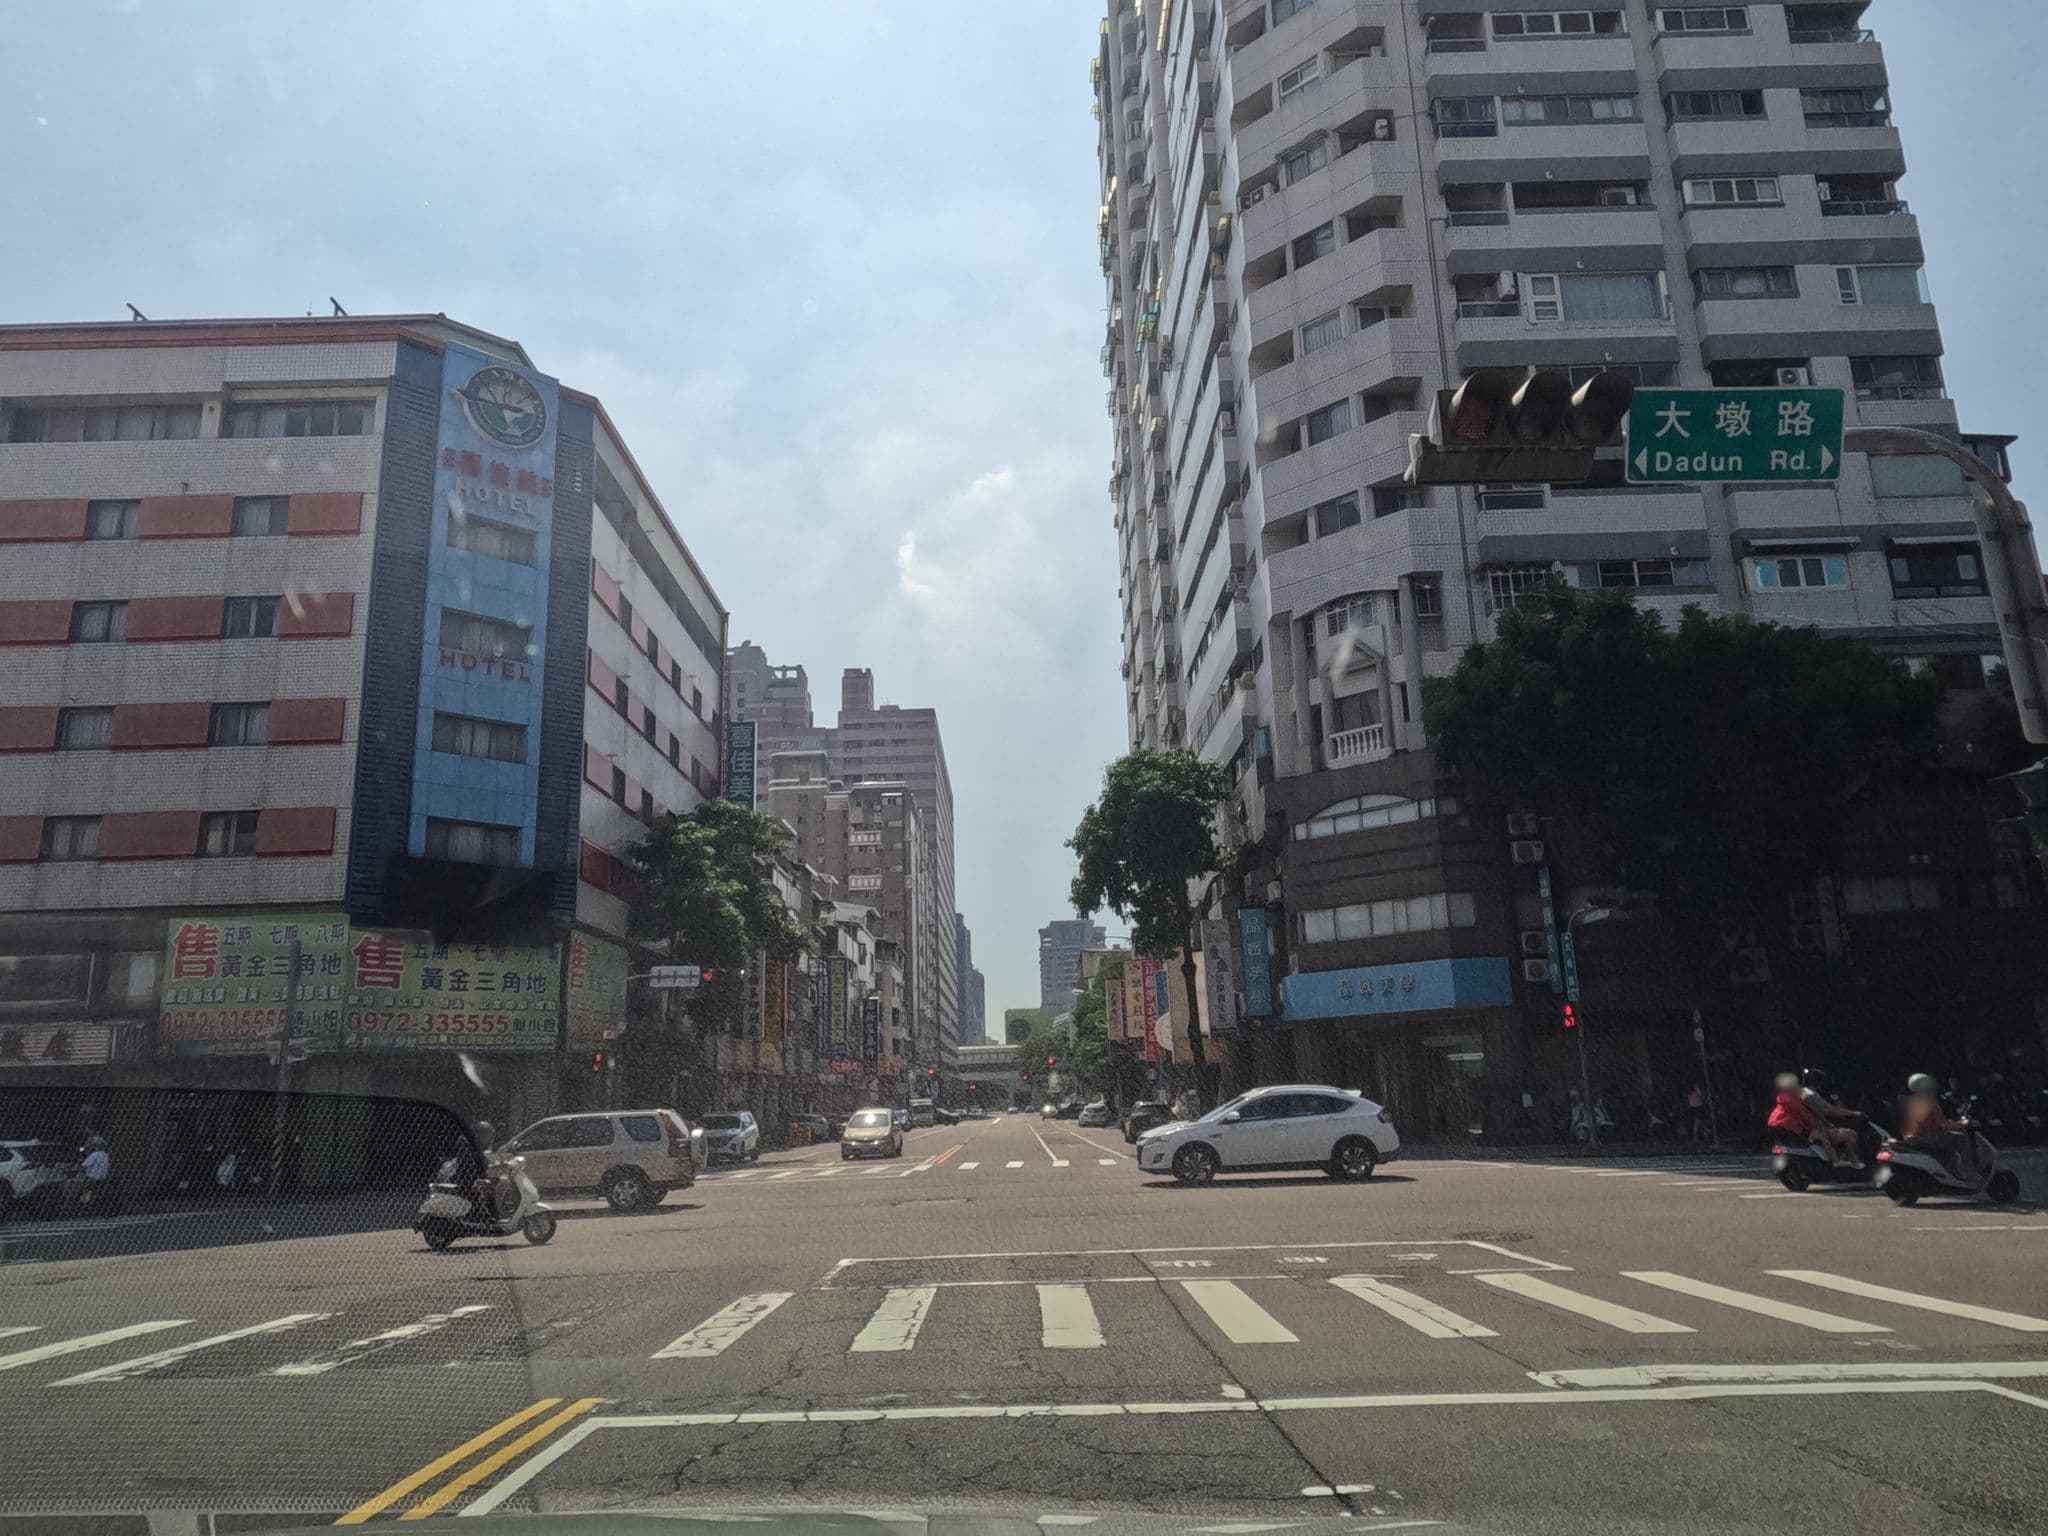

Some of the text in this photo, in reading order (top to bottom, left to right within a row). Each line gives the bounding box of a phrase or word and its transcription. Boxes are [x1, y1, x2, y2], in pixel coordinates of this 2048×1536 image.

[1655, 399, 1816, 439] 大墩路
[1655, 449, 1811, 473] Dadun Rd.
[455, 479, 537, 516] HOTEL
[438, 647, 532, 683] HOTEL
[728, 725, 754, 804] 喜佳美
[172, 922, 220, 981] 售
[220, 953, 342, 979] 黃金三角地
[352, 936, 405, 991] 售
[420, 966, 547, 994] 黃金三角地
[346, 1011, 510, 1034] 0972-335555
